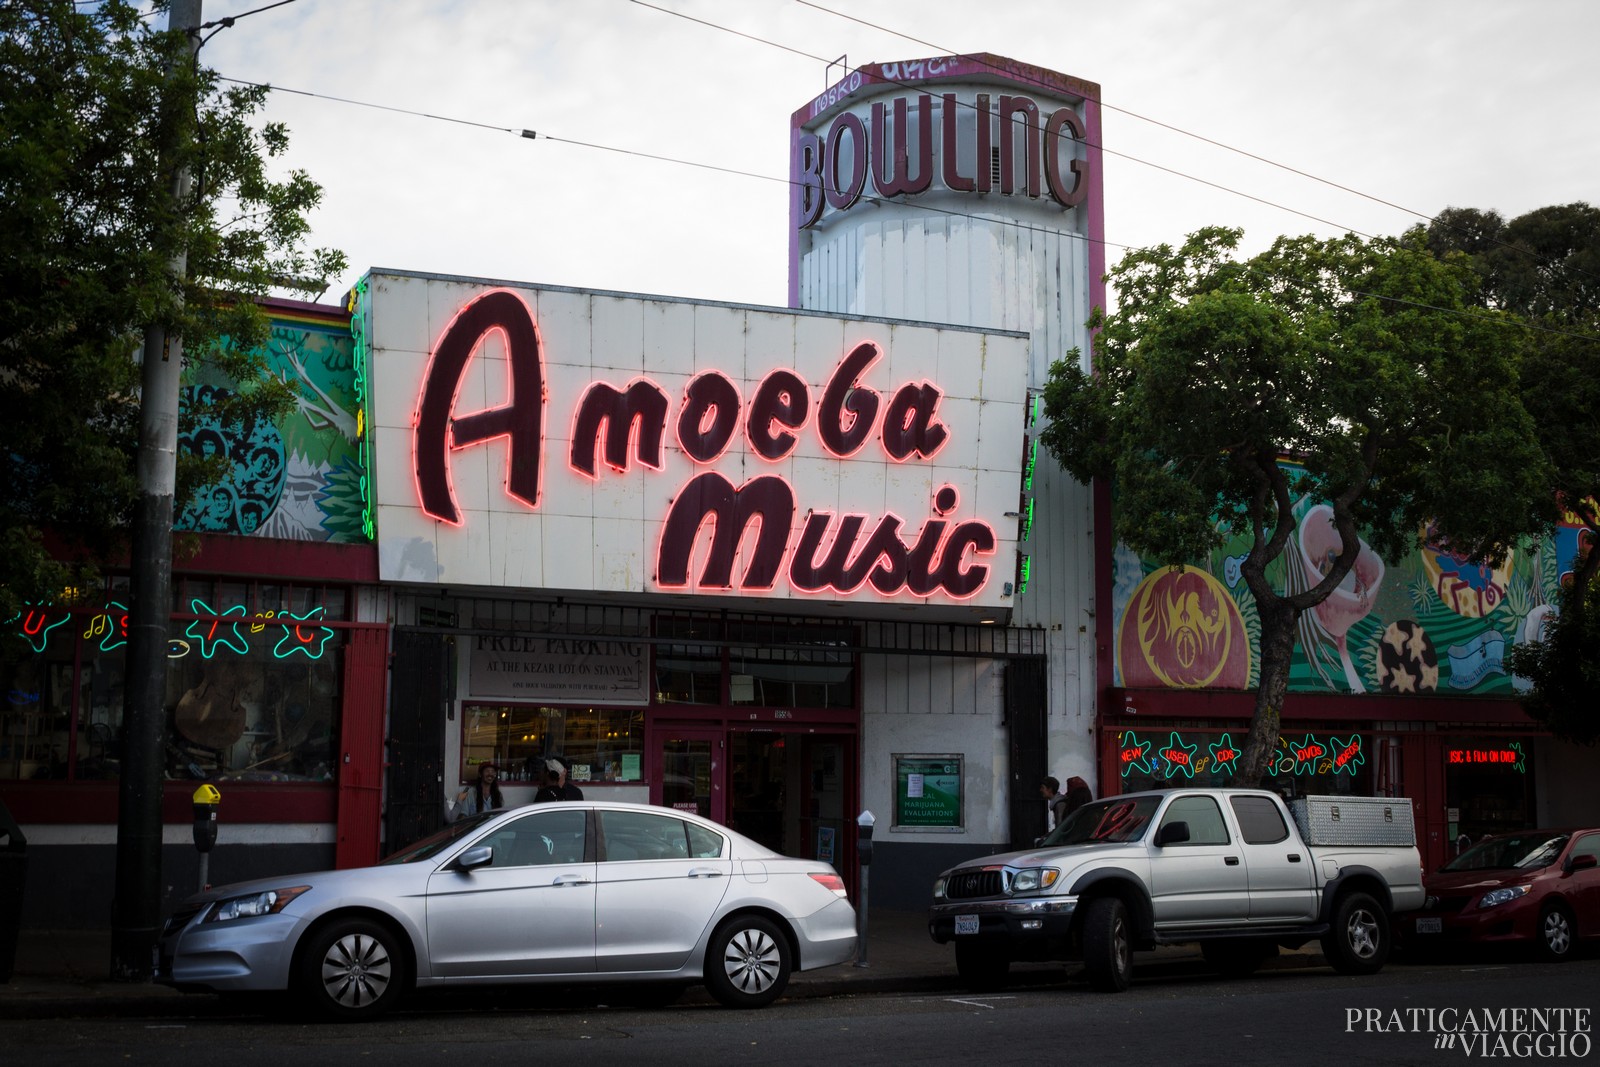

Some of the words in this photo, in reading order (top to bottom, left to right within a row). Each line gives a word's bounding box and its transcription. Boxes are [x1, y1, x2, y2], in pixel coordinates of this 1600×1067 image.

[798, 93, 1090, 232] BOWLING
[412, 286, 951, 527] Amoeba
[657, 470, 996, 600] Music
[477, 634, 536, 653] FREE
[545, 637, 642, 658] PARKING
[487, 661, 497, 672] AT
[502, 662, 520, 673] THE
[523, 663, 555, 674] KEZAR
[559, 664, 576, 675] LOT
[579, 665, 591, 675] ON
[594, 666, 633, 676] STANYAN
[1166, 749, 1189, 765] USED
[1335, 741, 1359, 766] VIDEOS
[1473, 750, 1487, 763] FILM
[1489, 750, 1499, 763] ON
